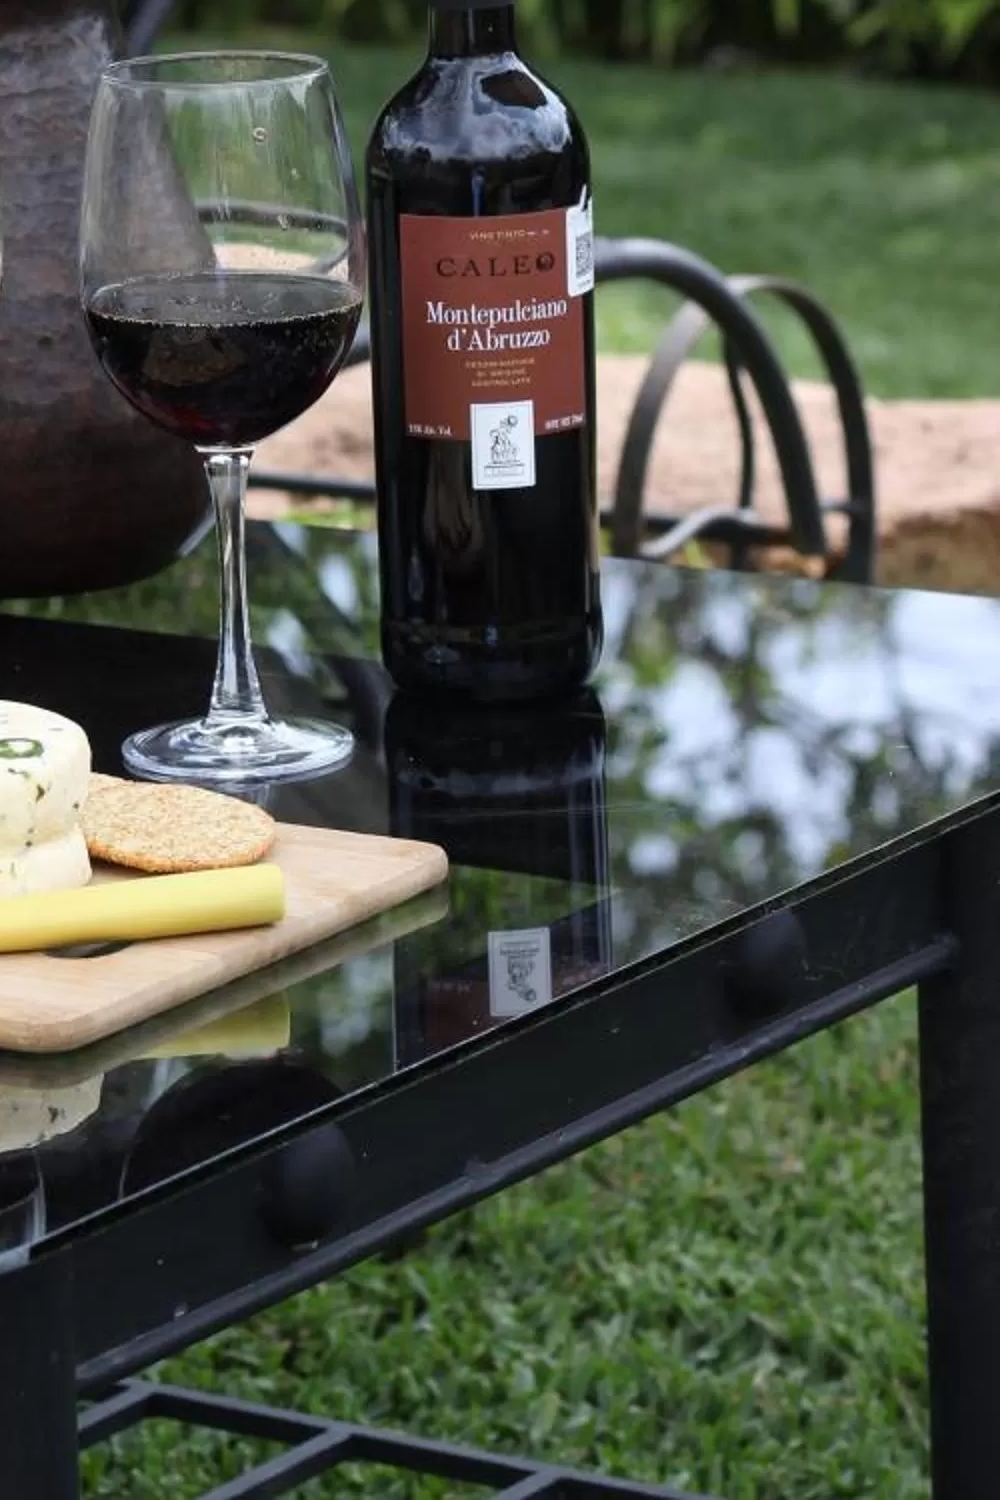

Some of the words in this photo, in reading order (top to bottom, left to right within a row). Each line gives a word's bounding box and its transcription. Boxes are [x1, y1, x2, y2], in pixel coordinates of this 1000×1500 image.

[436, 252, 555, 278] CALEO
[426, 298, 567, 329] Montepulciano
[447, 328, 550, 351] d'Abruzzo
